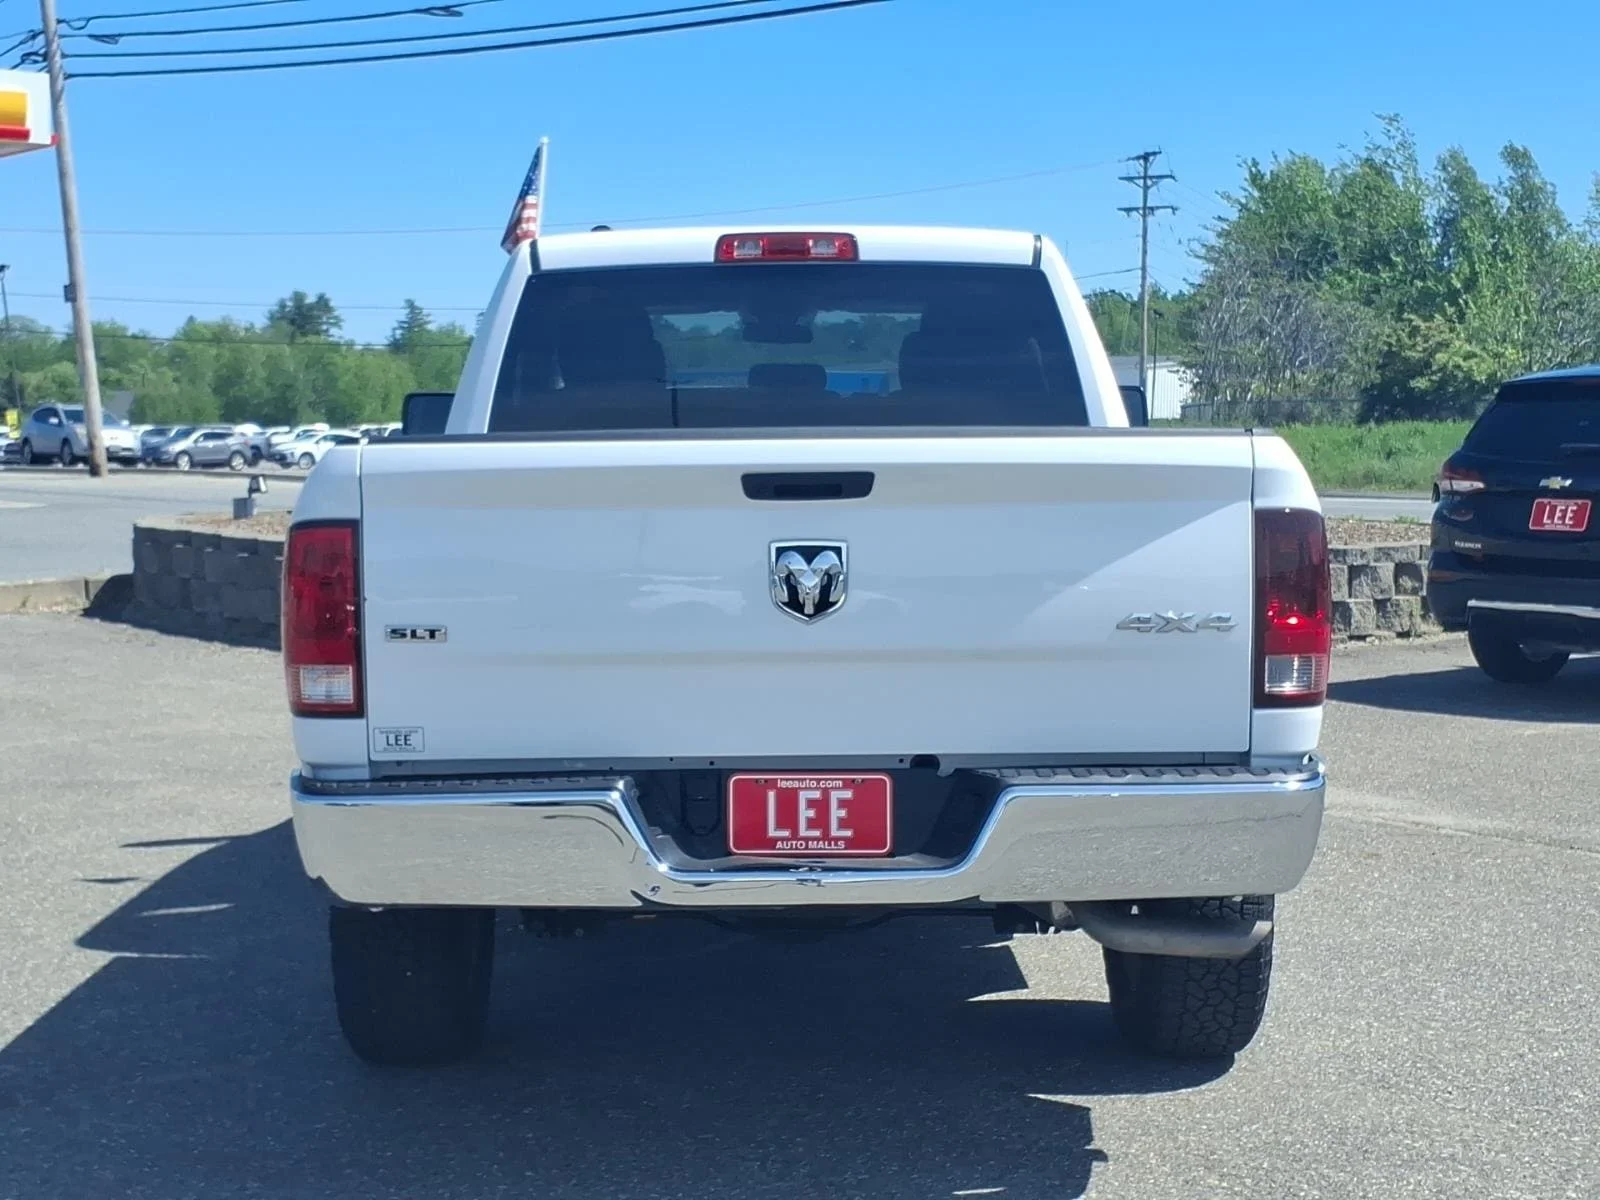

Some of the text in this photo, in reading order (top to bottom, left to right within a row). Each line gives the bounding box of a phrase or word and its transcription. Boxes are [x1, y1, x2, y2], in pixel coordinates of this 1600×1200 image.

[1543, 506, 1577, 524] LEE
[1116, 611, 1238, 633] 4X4
[388, 627, 442, 640] SLT
[386, 735, 413, 747] LEE
[777, 778, 843, 788] leeauto.com
[766, 789, 854, 838] LEE
[775, 840, 845, 849] AUTO MALLS
